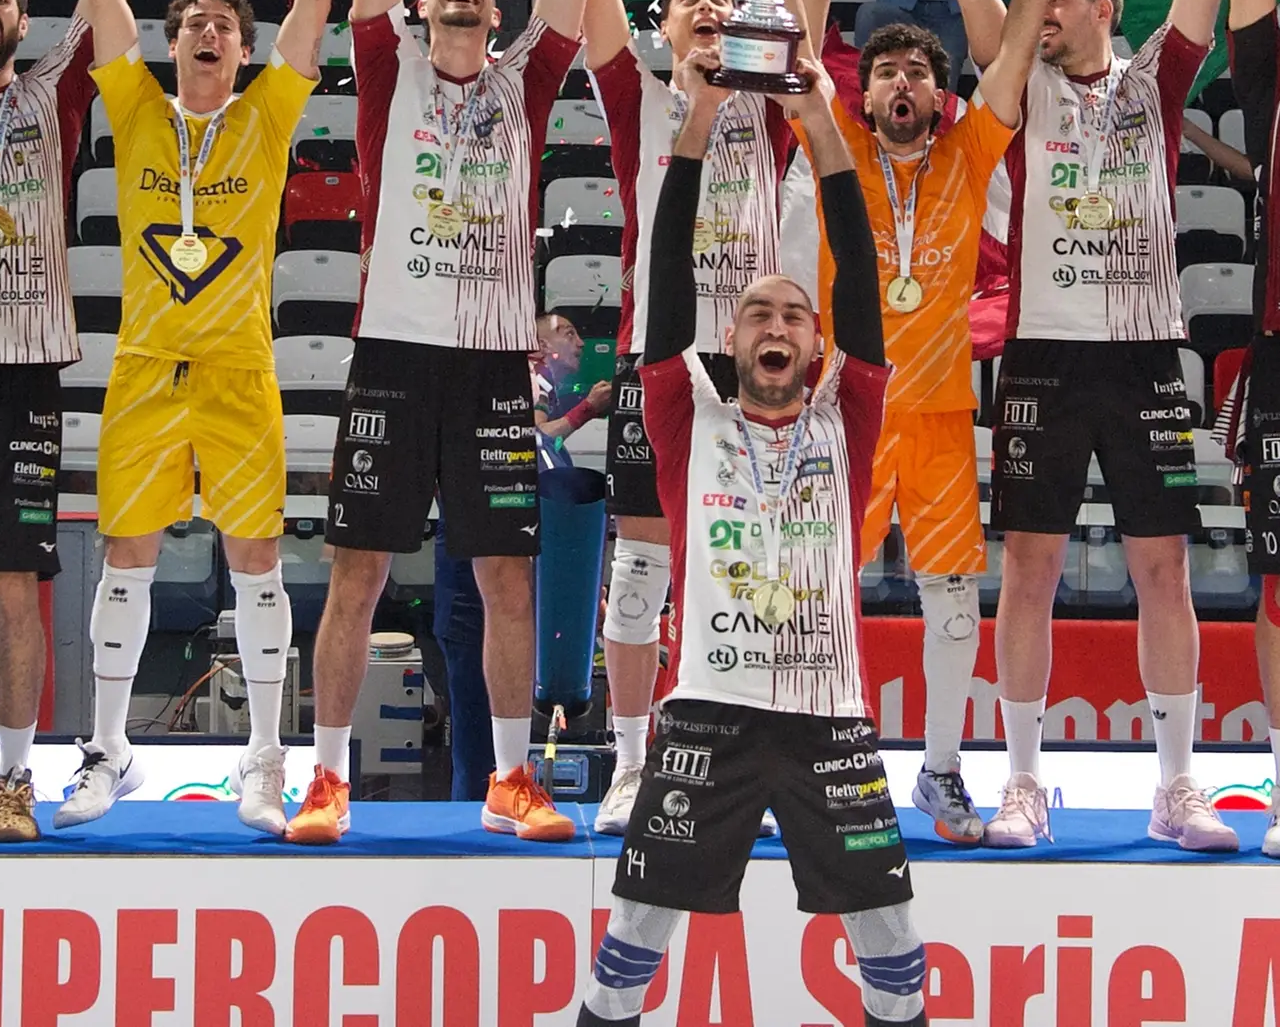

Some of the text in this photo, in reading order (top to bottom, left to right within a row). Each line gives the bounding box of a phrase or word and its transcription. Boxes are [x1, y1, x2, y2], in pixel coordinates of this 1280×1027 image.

[1053, 237, 1151, 256] CANALE
[435, 262, 457, 274] CTL
[1081, 270, 1103, 280] CTL
[1106, 269, 1151, 280] ECOLOGY
[476, 427, 508, 439] CLINICA
[616, 445, 650, 461] OASI
[345, 474, 379, 491] OASI
[1262, 531, 1278, 555] 10
[744, 651, 771, 664] CTL
[775, 651, 834, 665] ECOLOGY
[814, 757, 852, 774] CLINICA
[648, 816, 695, 839] OASI
[836, 823, 873, 833] Polimeni
[626, 847, 646, 879] 14
[801, 915, 1187, 1027] Serie
